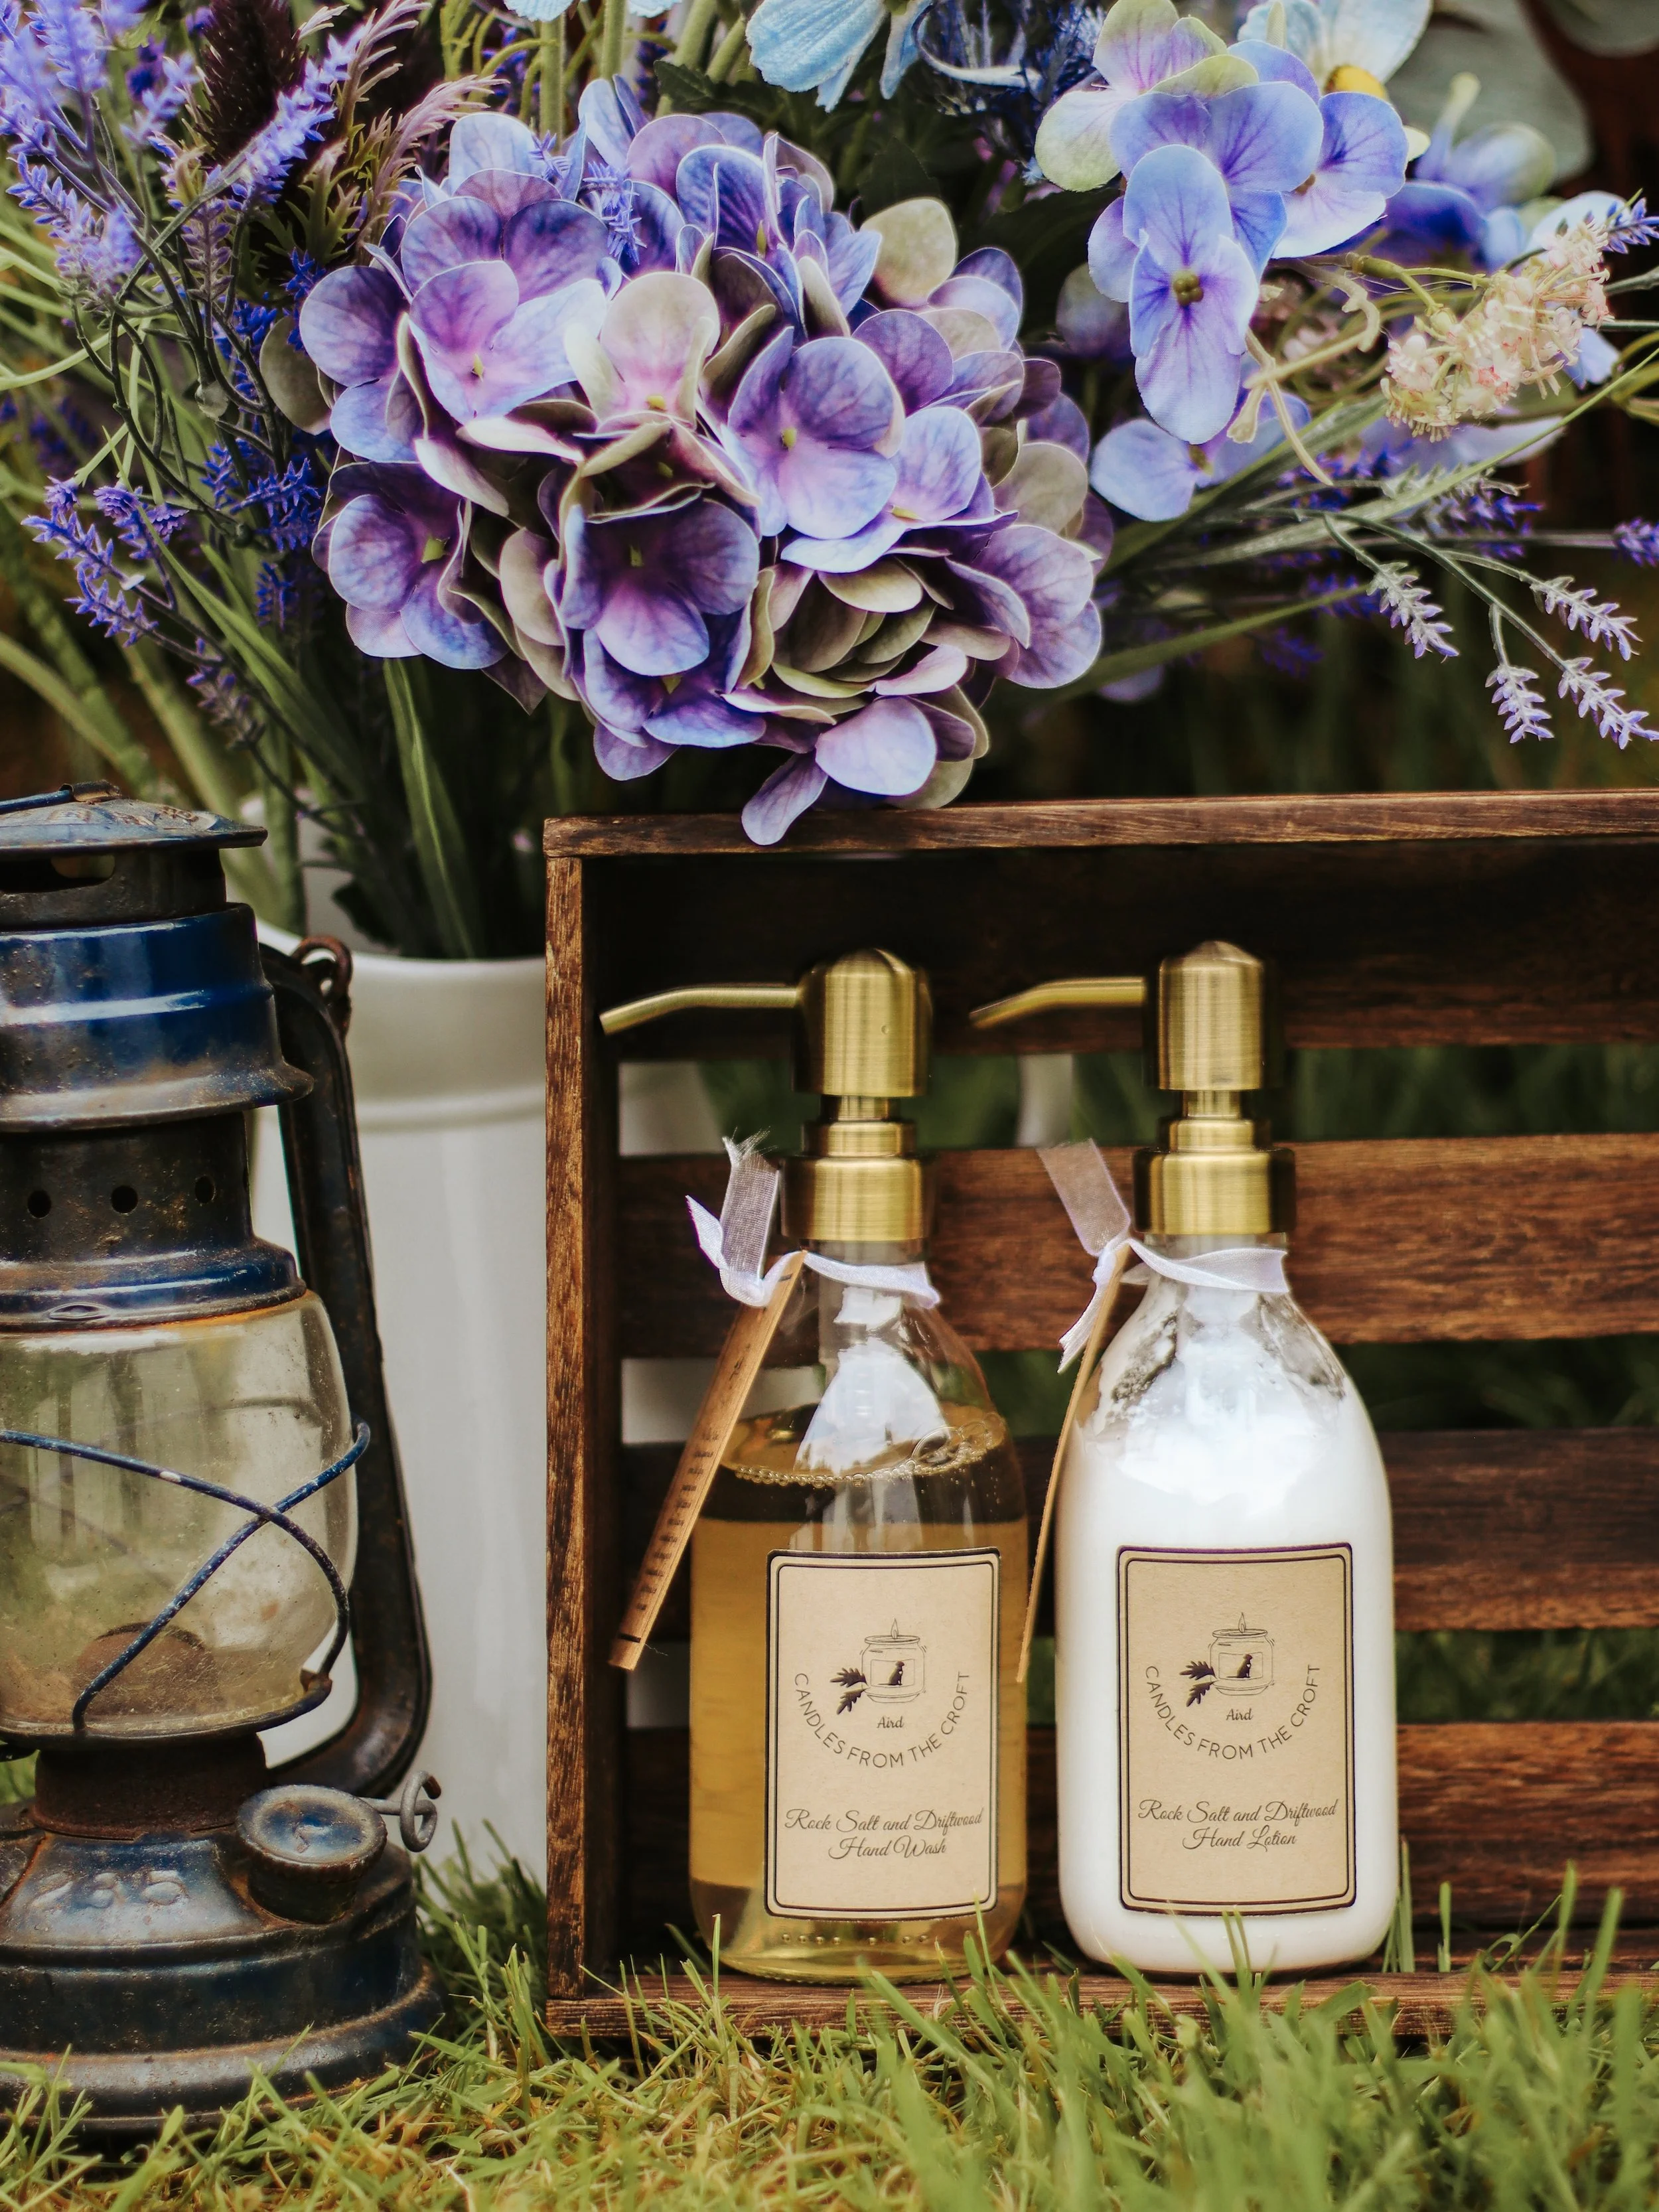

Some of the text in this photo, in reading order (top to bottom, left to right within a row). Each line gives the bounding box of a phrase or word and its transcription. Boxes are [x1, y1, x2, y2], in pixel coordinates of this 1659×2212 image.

[794, 1670, 970, 1768] CANDLES FROM THE CROFT
[877, 1716, 904, 1729] Aird
[1145, 1664, 1320, 1759] CANDLES FROM THE CROFT
[1226, 1707, 1254, 1721] Aird
[784, 1807, 984, 1836] Rock Salt and Driftwood
[1137, 1799, 1338, 1826] Rock Salt and Driftwood
[828, 1834, 946, 1860] Hand Wash
[1182, 1824, 1297, 1852] Hand Lotion
